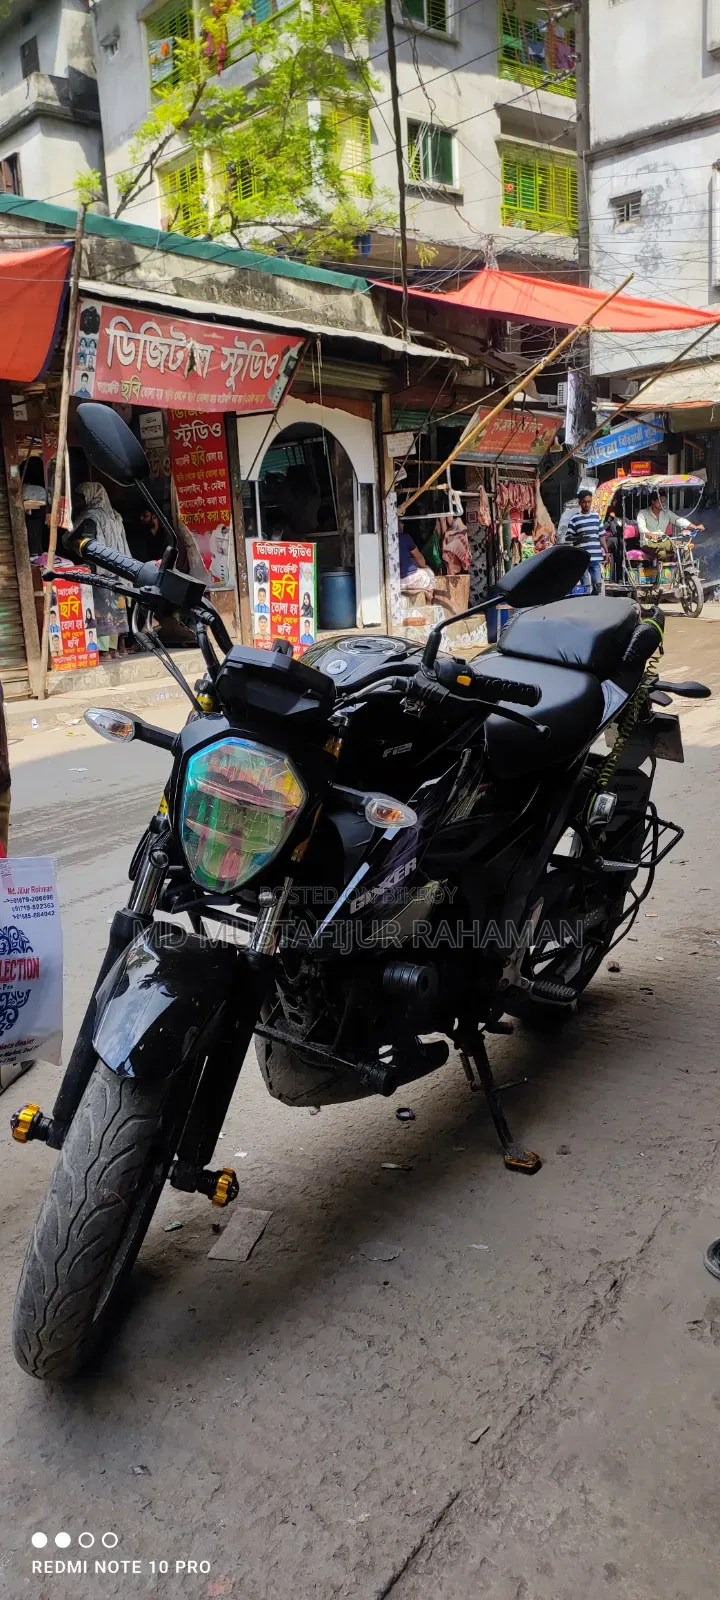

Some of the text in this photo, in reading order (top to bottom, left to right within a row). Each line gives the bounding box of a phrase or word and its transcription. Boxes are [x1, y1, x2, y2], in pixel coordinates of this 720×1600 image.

[105, 315, 280, 392] ডিজিটাল স্টুডিও
[120, 374, 143, 401] ছবি
[173, 419, 222, 448] স্টুডিও
[190, 445, 206, 467] ছবি
[256, 542, 312, 560] ডিজিটাল স্টুডিও
[271, 564, 298, 574] আর্জেন্ট
[57, 586, 80, 597] আর্জেন্ট
[271, 574, 299, 600] ছবি
[59, 595, 81, 619] ছবি
[271, 602, 299, 616] তোলা হয়
[61, 620, 75, 631] তোলা
[277, 623, 293, 636] ছবি
[67, 637, 80, 648] ছবি
